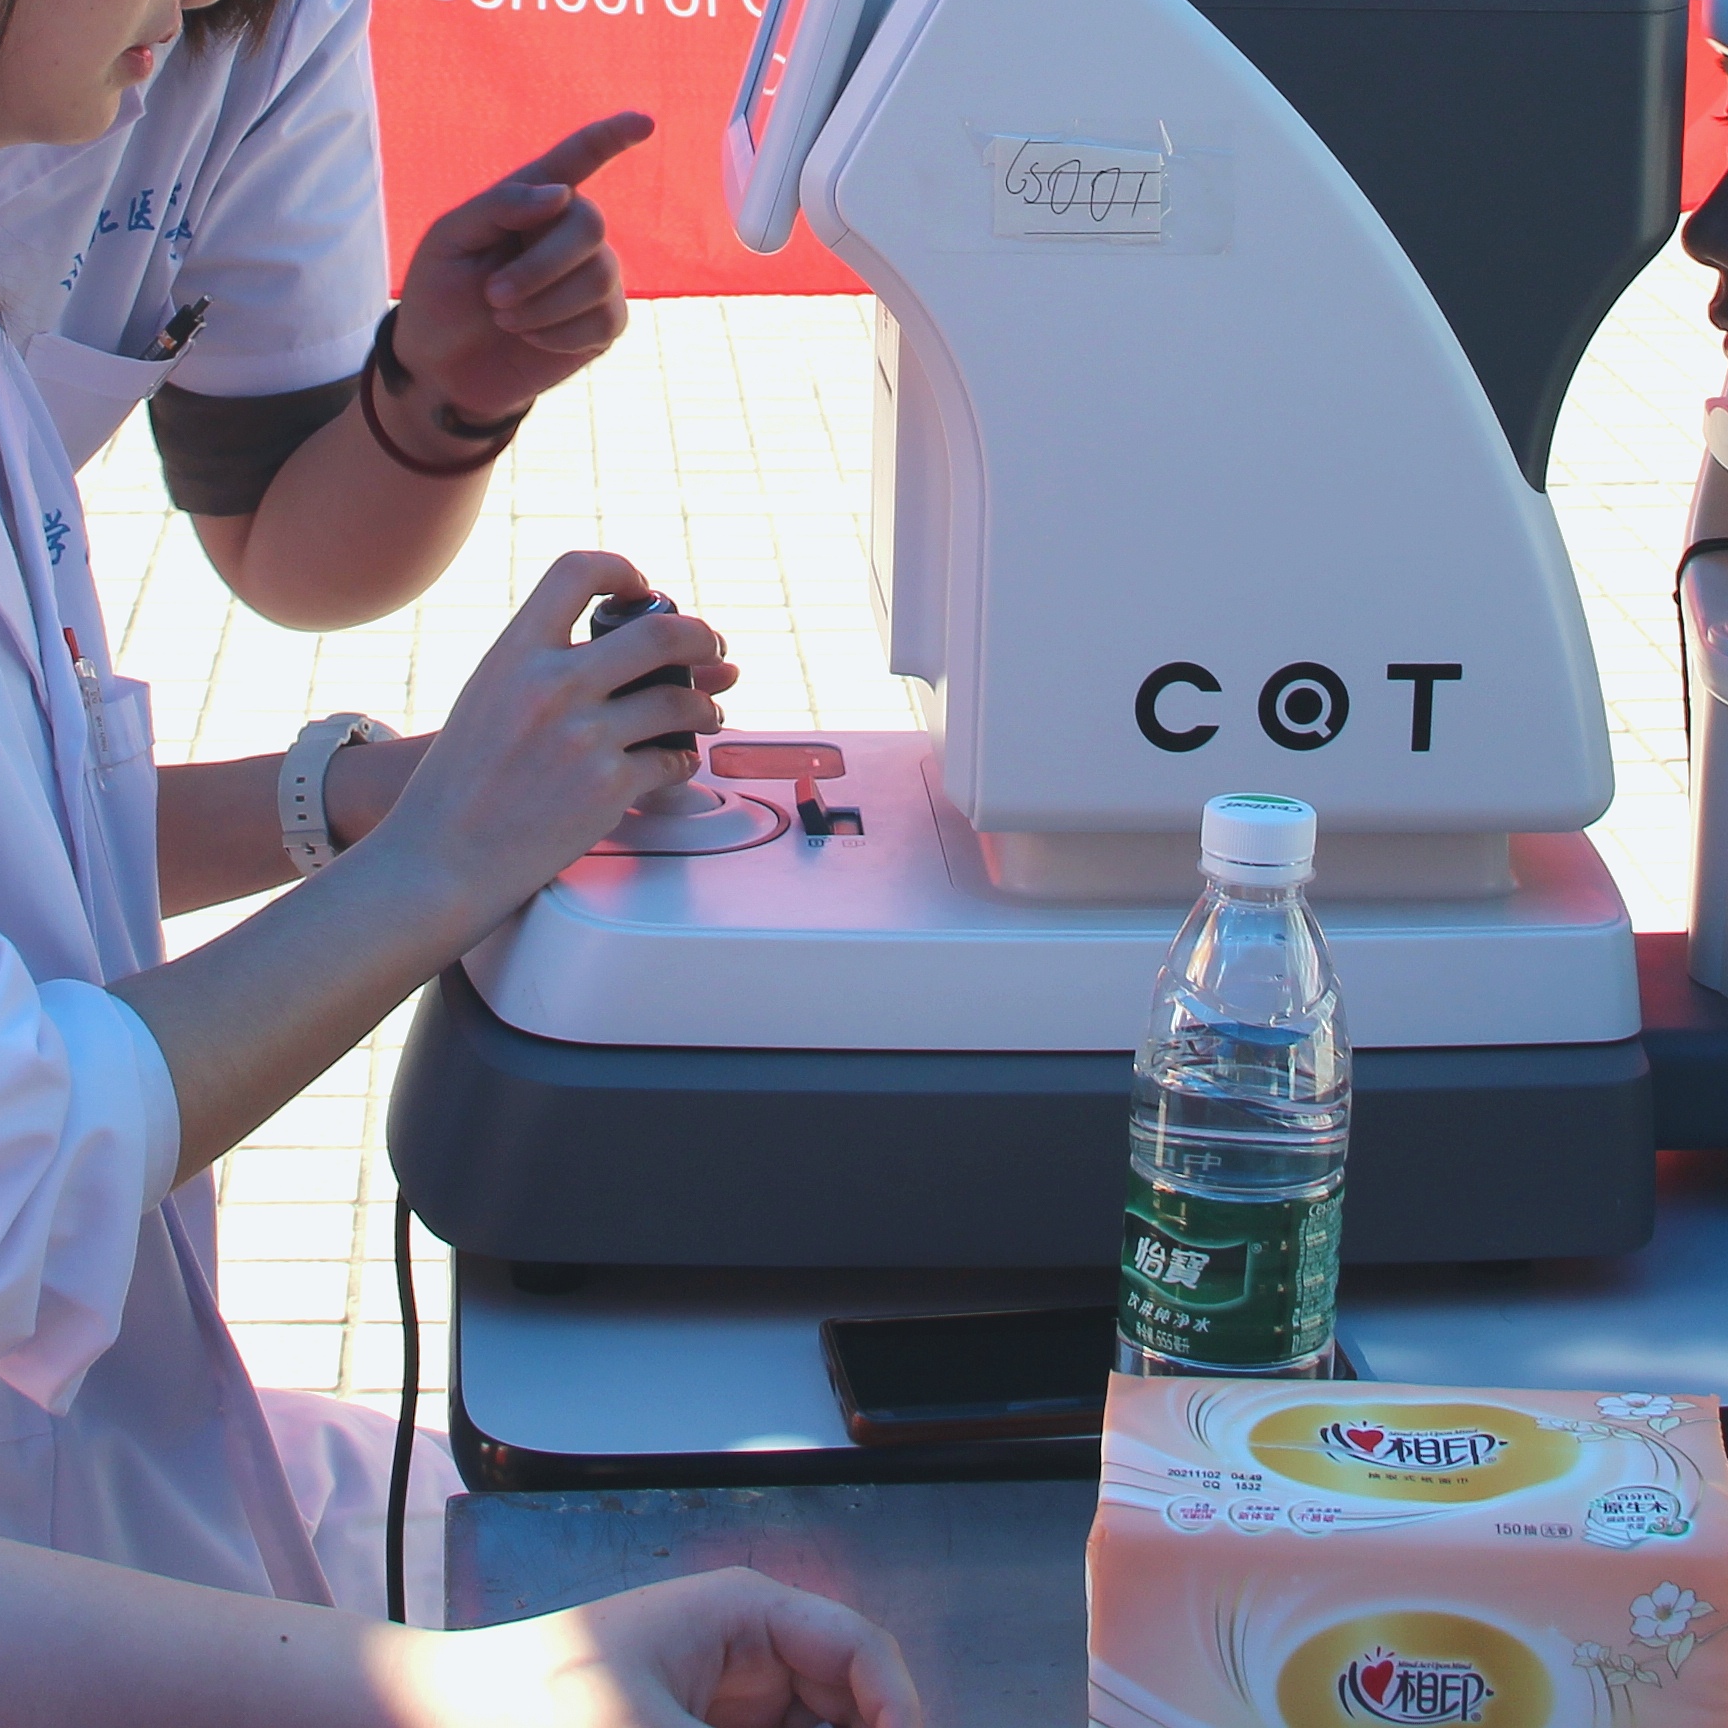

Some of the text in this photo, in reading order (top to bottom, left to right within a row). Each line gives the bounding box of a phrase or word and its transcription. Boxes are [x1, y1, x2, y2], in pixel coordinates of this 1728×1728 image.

[1134, 1236, 1210, 1290] 怡寶
[1167, 1468, 1221, 1480] 20211102
[1202, 1480, 1262, 1491] CQ 1532
